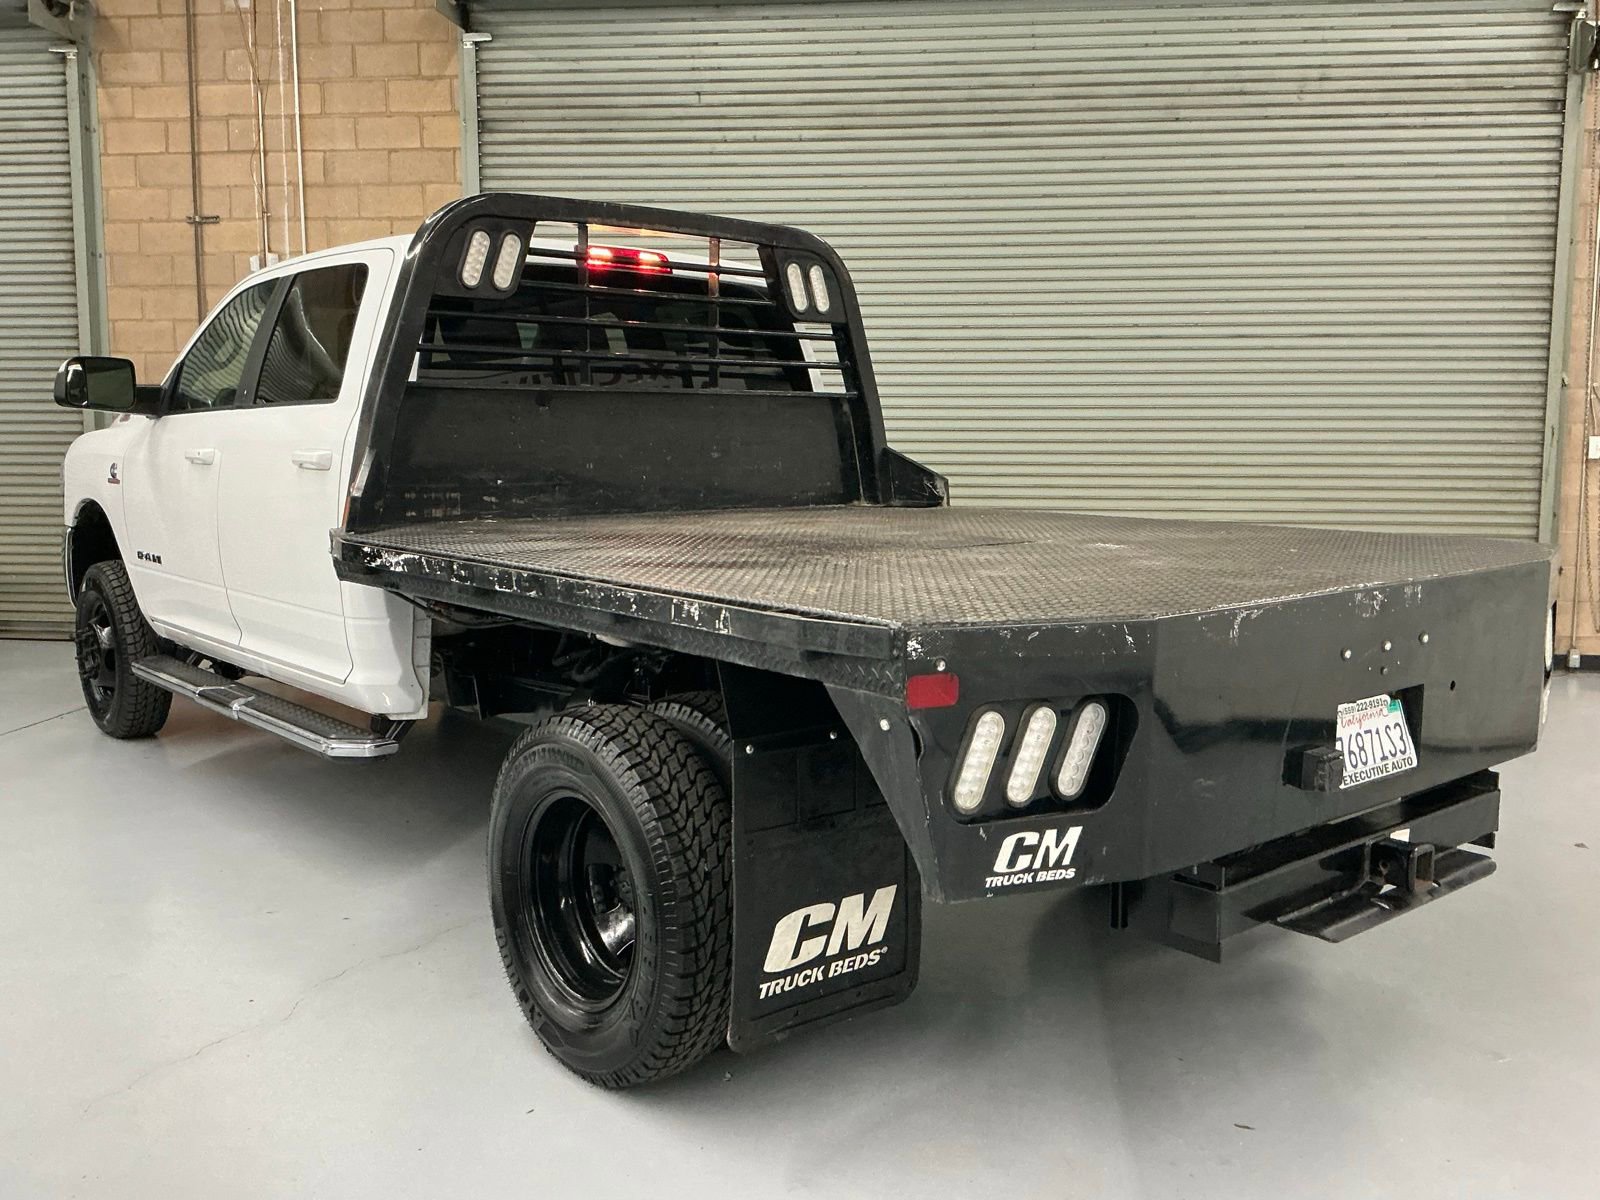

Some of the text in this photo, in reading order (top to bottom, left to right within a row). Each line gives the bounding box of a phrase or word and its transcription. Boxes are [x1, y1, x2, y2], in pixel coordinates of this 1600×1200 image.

[1340, 708, 1389, 729] California
[1342, 756, 1413, 786] EXECUTIVE AUTO
[993, 825, 1083, 873] CM
[985, 868, 1076, 888] TRUCK BEDS
[763, 884, 898, 973] CM
[759, 965, 826, 1000] TRUCK
